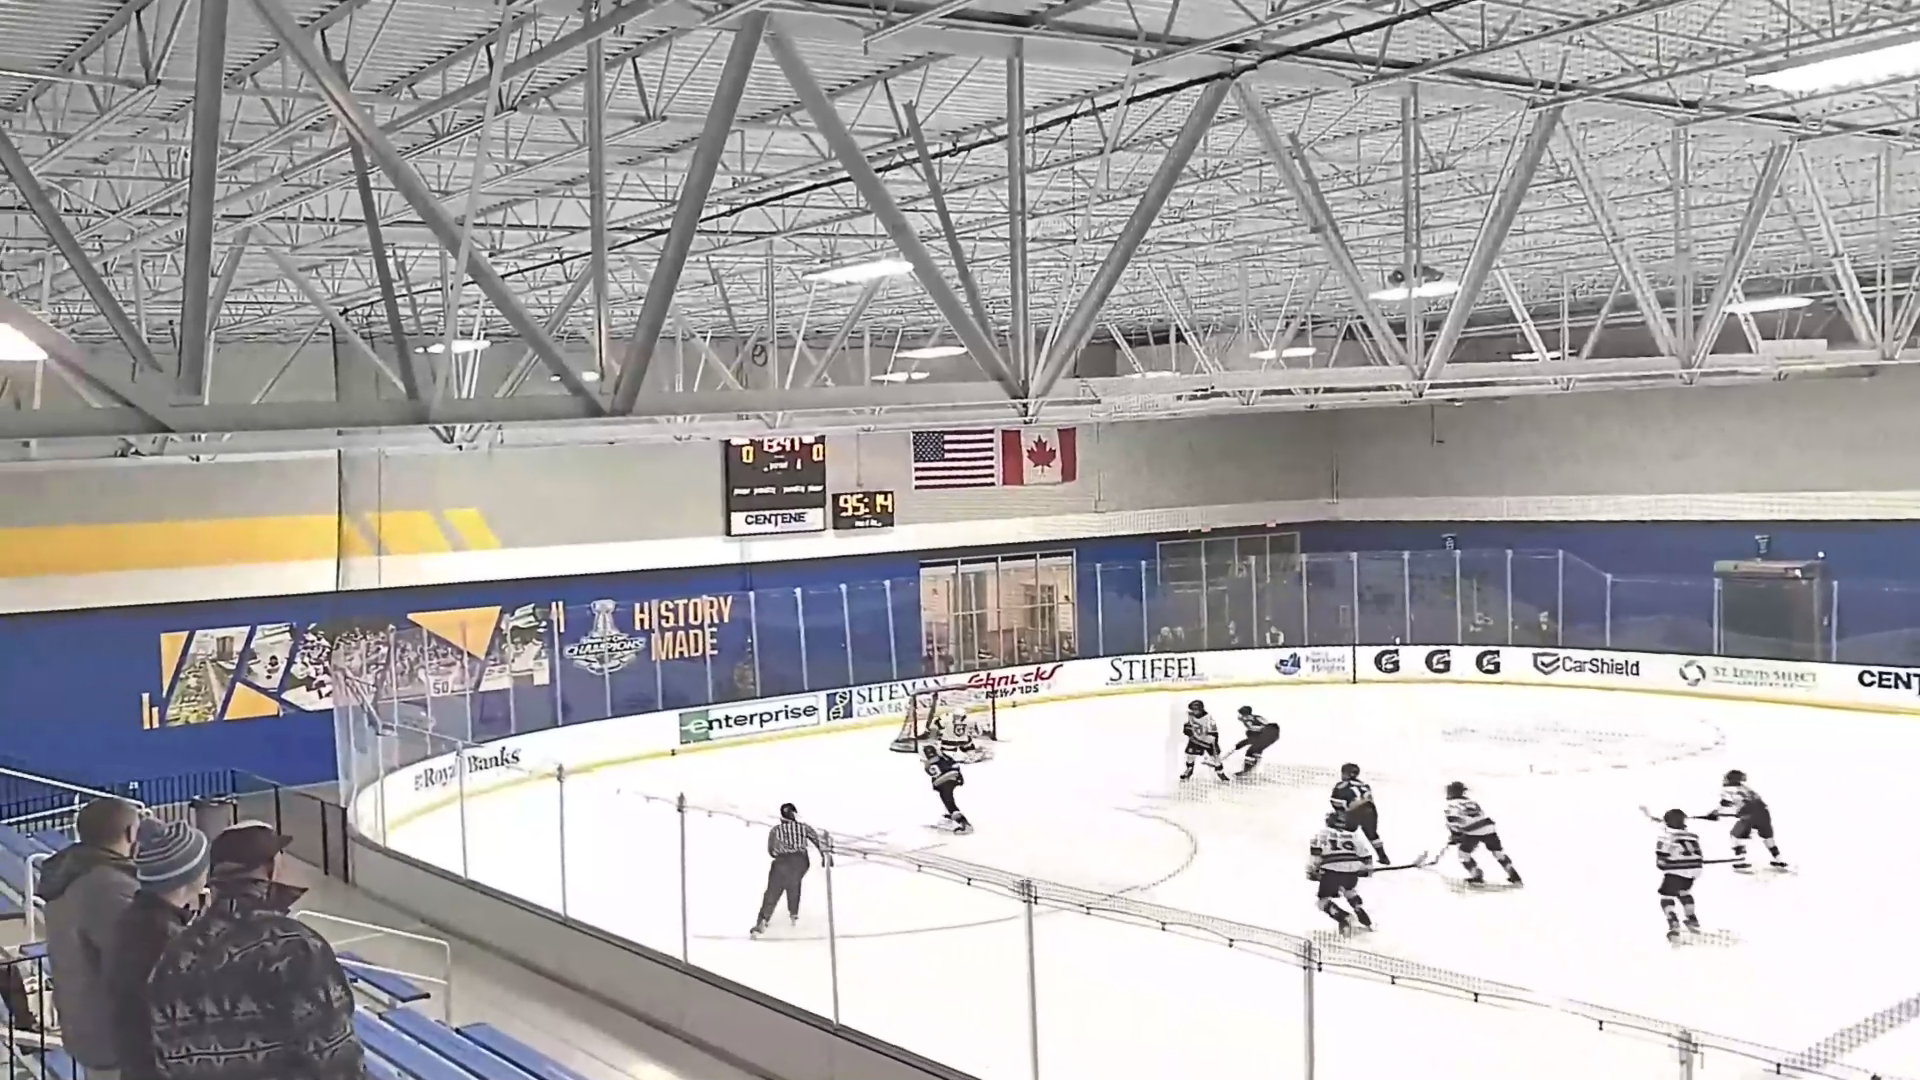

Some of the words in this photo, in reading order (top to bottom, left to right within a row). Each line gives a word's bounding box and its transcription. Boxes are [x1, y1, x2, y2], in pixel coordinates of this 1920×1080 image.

[742, 446, 754, 464] 0
[812, 444, 824, 462] 0
[745, 512, 806, 528] CENTENE
[635, 596, 732, 631] HISTORY
[565, 638, 645, 656] CHAMPIONS
[652, 628, 719, 661] MADE
[1562, 656, 1640, 677] CarShield
[686, 704, 818, 733] enterprise
[467, 746, 522, 774] Banks
